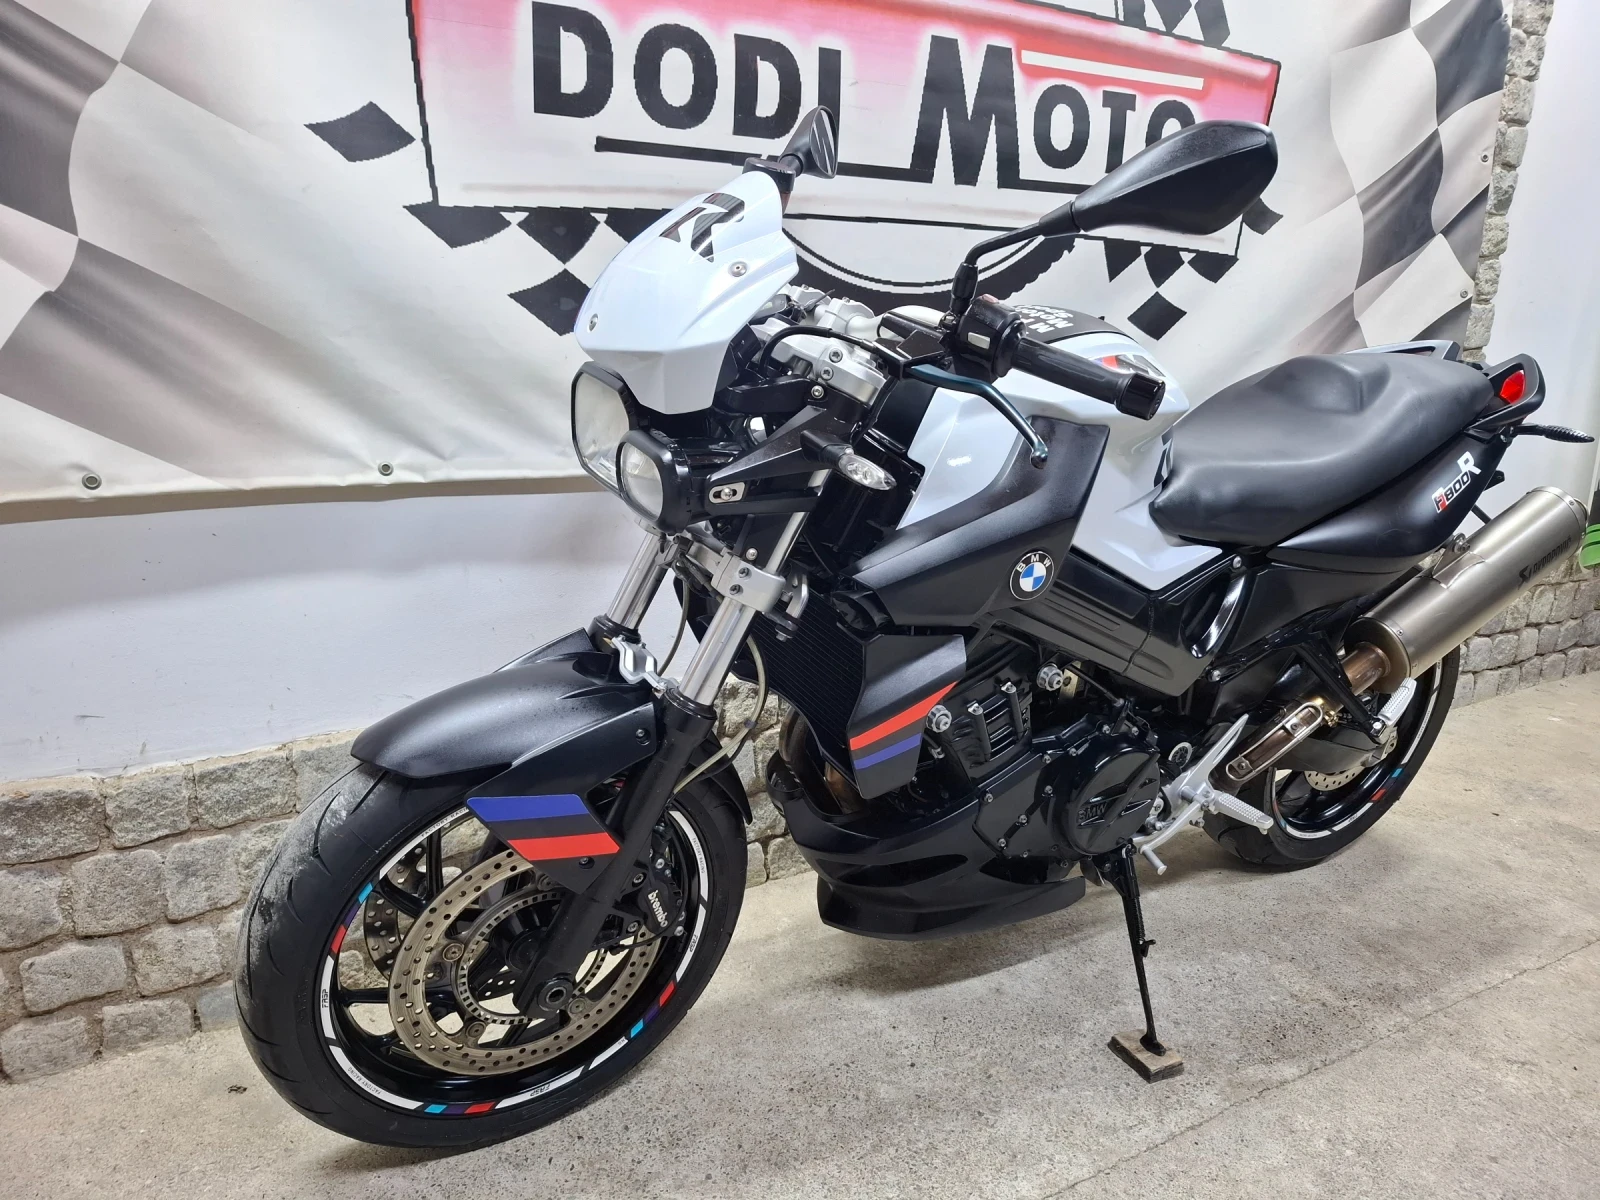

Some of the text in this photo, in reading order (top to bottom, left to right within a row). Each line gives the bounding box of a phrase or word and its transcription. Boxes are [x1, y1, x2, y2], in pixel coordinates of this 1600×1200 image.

[532, 1, 842, 150] DODI
[1432, 451, 1481, 513] F800R
[1016, 553, 1052, 573] BMW
[1078, 802, 1108, 822] BMW
[421, 818, 449, 837] FACTORY
[648, 889, 668, 928] brembo
